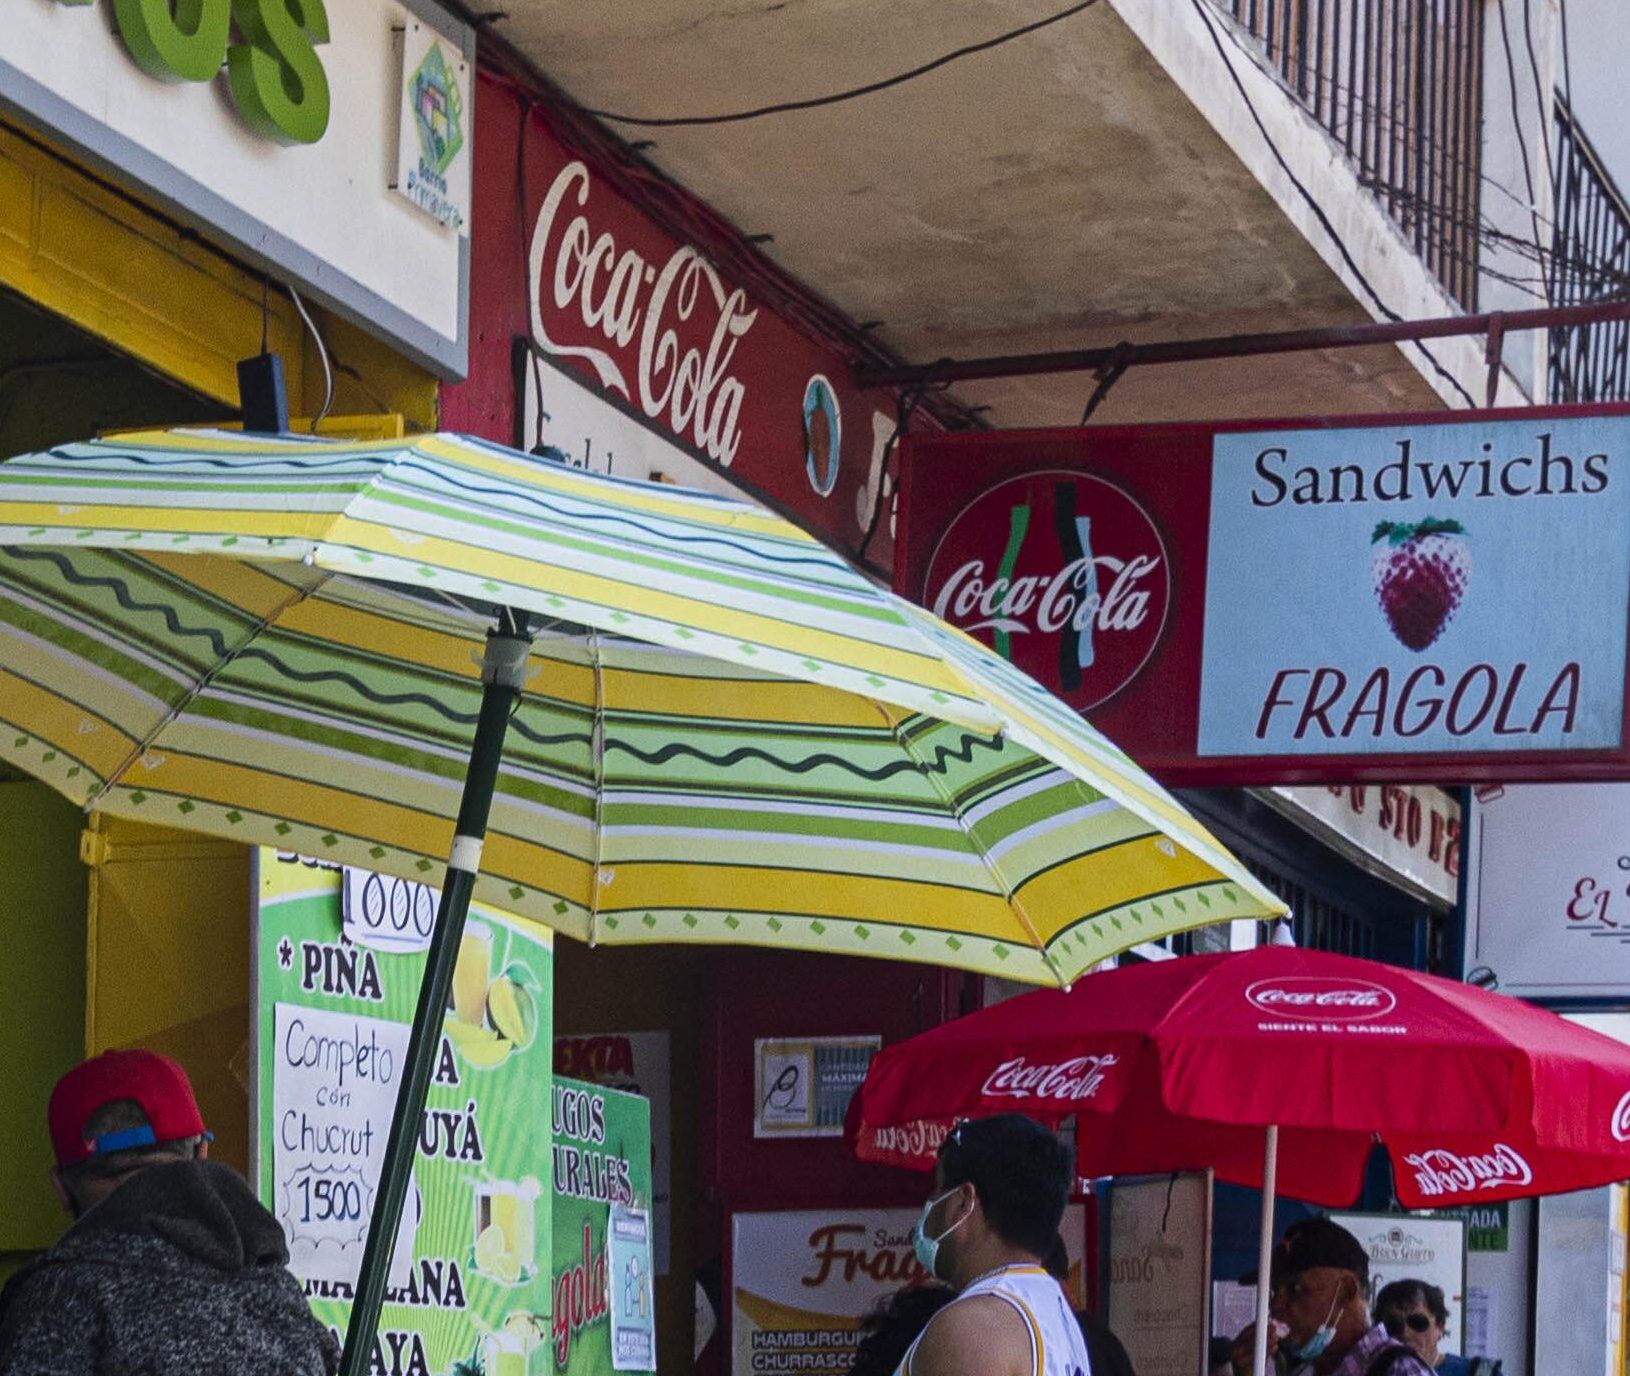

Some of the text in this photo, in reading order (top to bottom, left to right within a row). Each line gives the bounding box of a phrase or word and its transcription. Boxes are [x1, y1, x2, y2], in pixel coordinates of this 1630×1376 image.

[528, 160, 759, 468] Coca-Cola
[1250, 434, 1610, 508] Sandwichs
[933, 550, 1162, 635] Coca-Cola
[1255, 661, 1582, 740] FRAGOLA
[302, 934, 383, 999] PIÑA
[285, 1019, 395, 1086] Completo
[1257, 1022, 1408, 1036] SIENTE EL SABOR
[819, 1062, 867, 1072] CANTIDA
[980, 1052, 1120, 1101] Coca-Cola
[281, 1109, 374, 1158] Chucrut
[552, 1086, 606, 1146] UGOS
[296, 1177, 363, 1223] 1500
[552, 1146, 634, 1206] URALES
[801, 1222, 936, 1288] Frag
[873, 1229, 916, 1249] Sand
